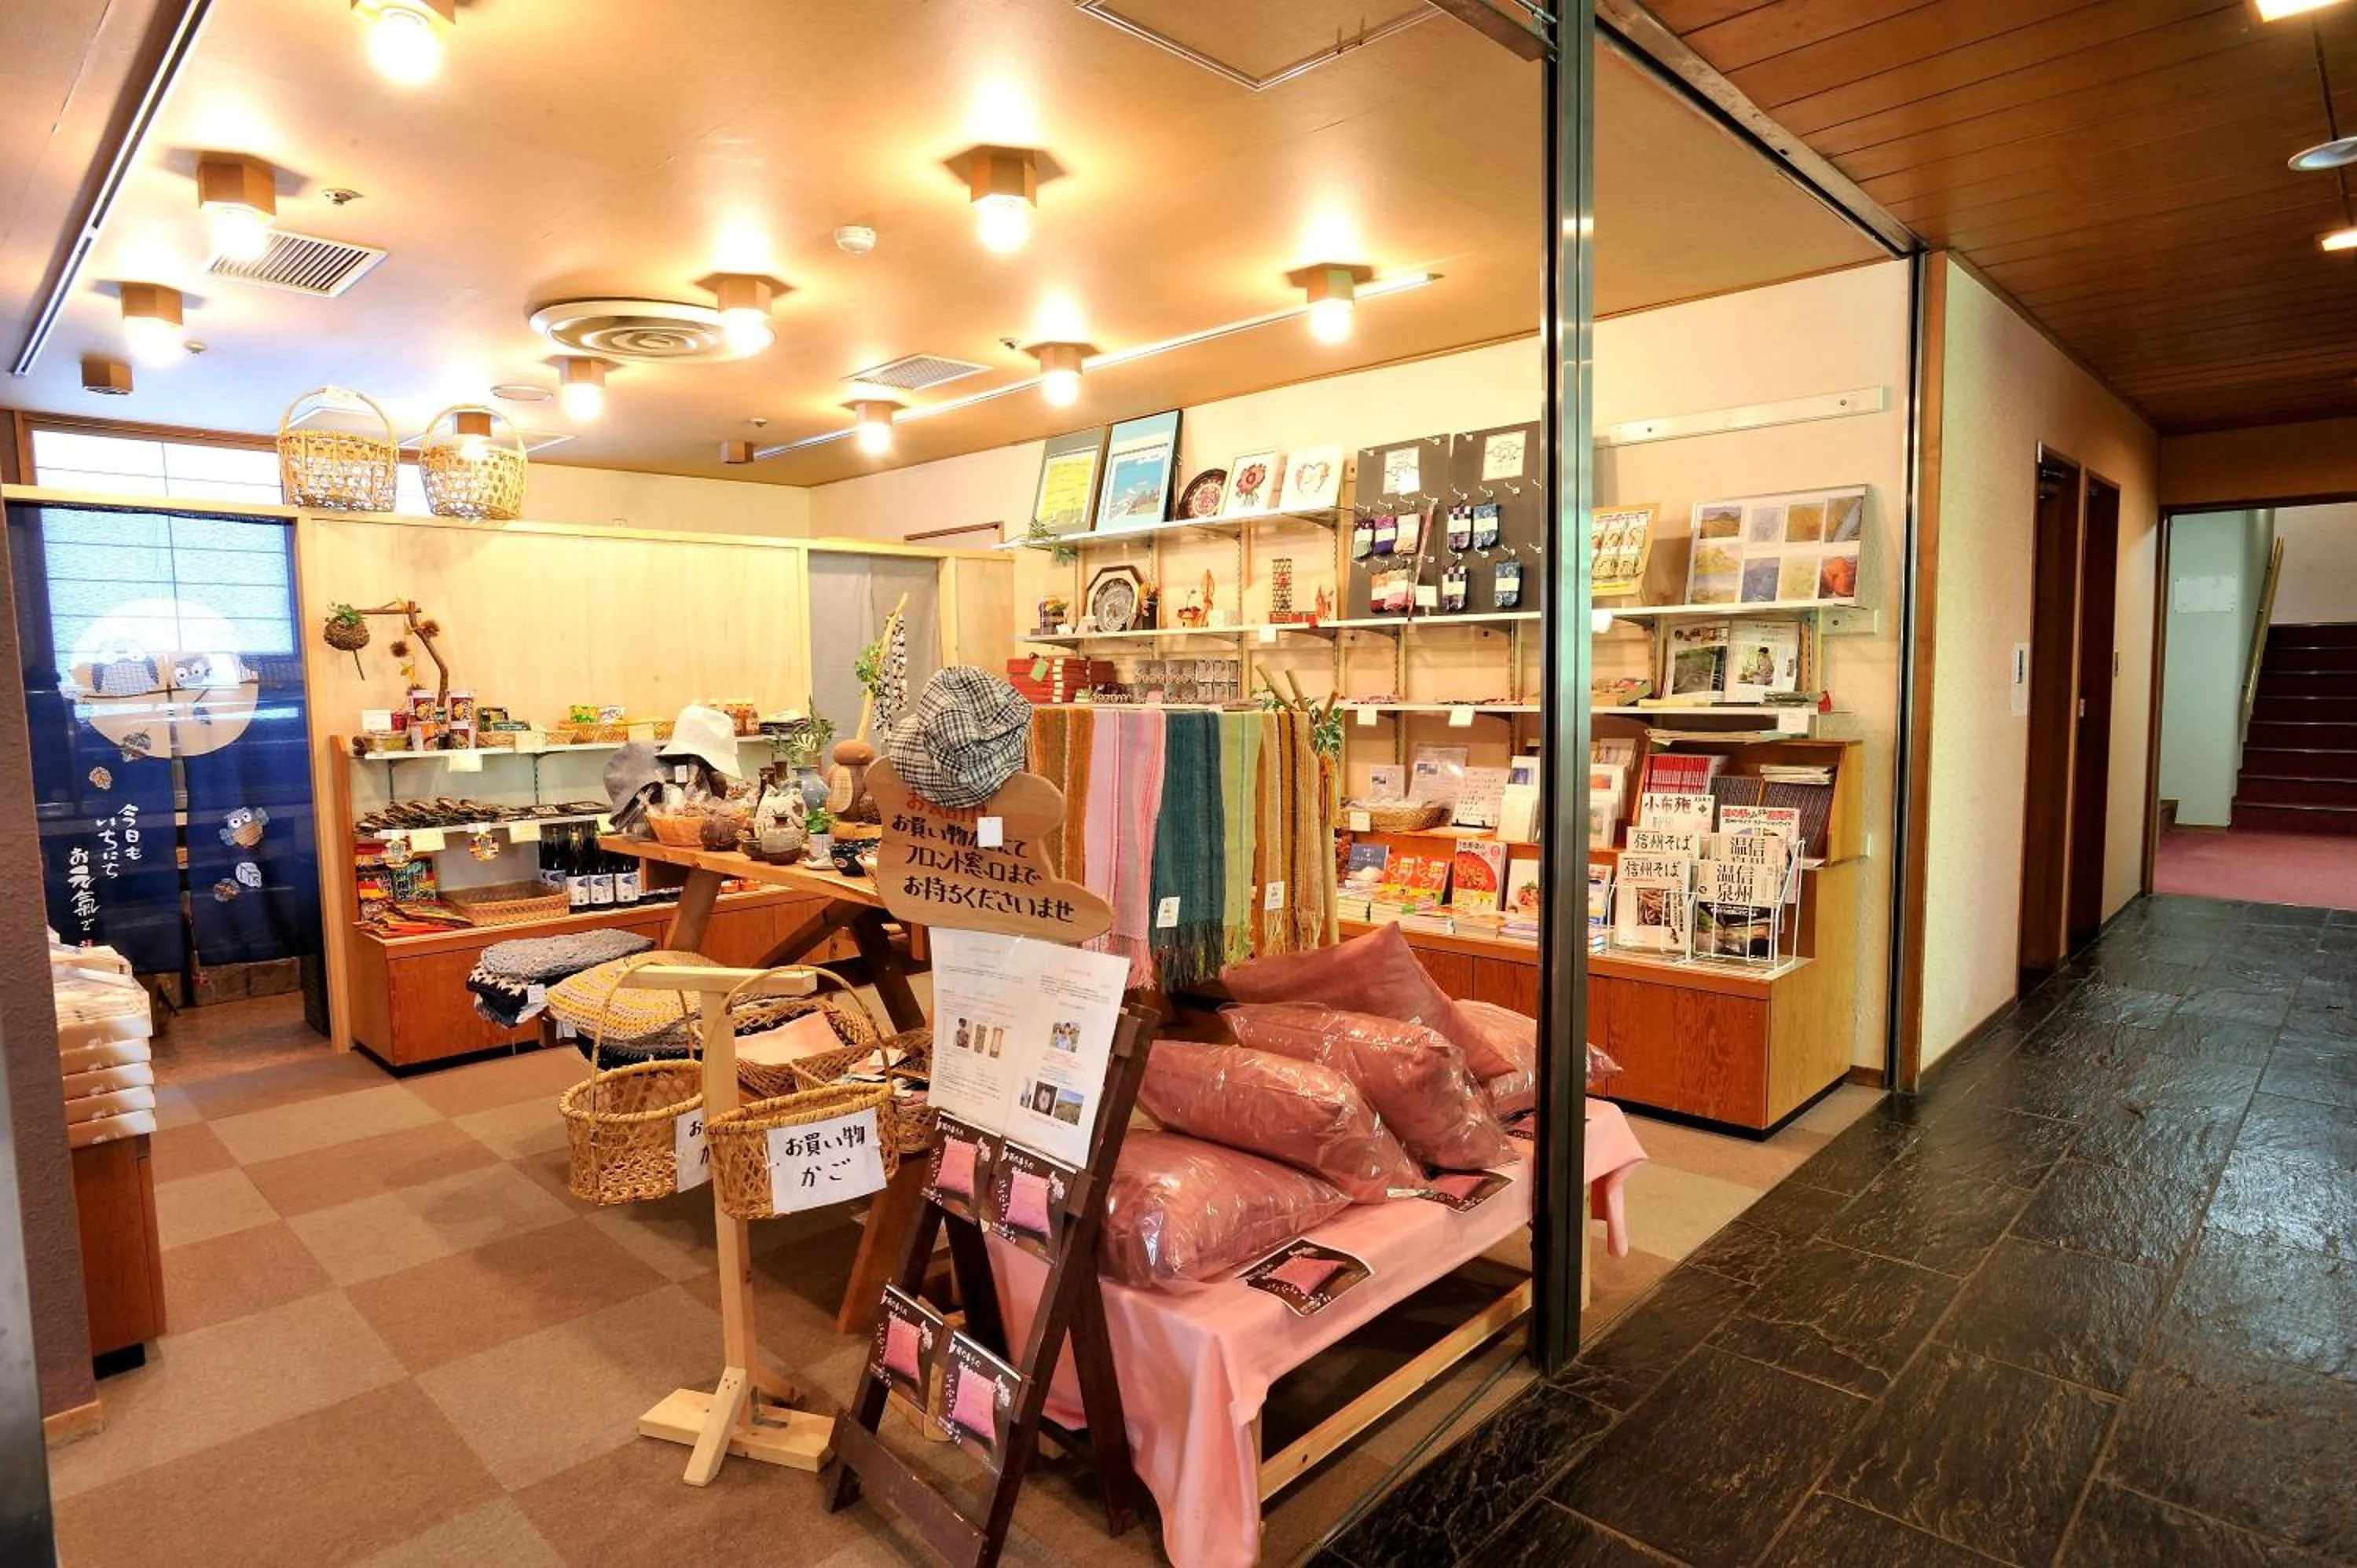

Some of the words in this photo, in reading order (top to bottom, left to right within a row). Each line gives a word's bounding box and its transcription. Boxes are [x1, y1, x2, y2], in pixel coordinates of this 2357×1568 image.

[96, 817, 119, 879] いちにち
[118, 804, 142, 860] 今日も
[892, 815, 1028, 859] お買い物かにて
[1633, 833, 1693, 851] 信州そば
[904, 844, 1043, 887] フロント窓口まで
[1625, 861, 1681, 877] 信州そば
[1717, 864, 1735, 903] 温泉
[1735, 865, 1754, 903] 信州
[904, 874, 1075, 924] お持ちくださいませ
[785, 1124, 866, 1157] お買い物
[801, 1157, 852, 1188] かご
